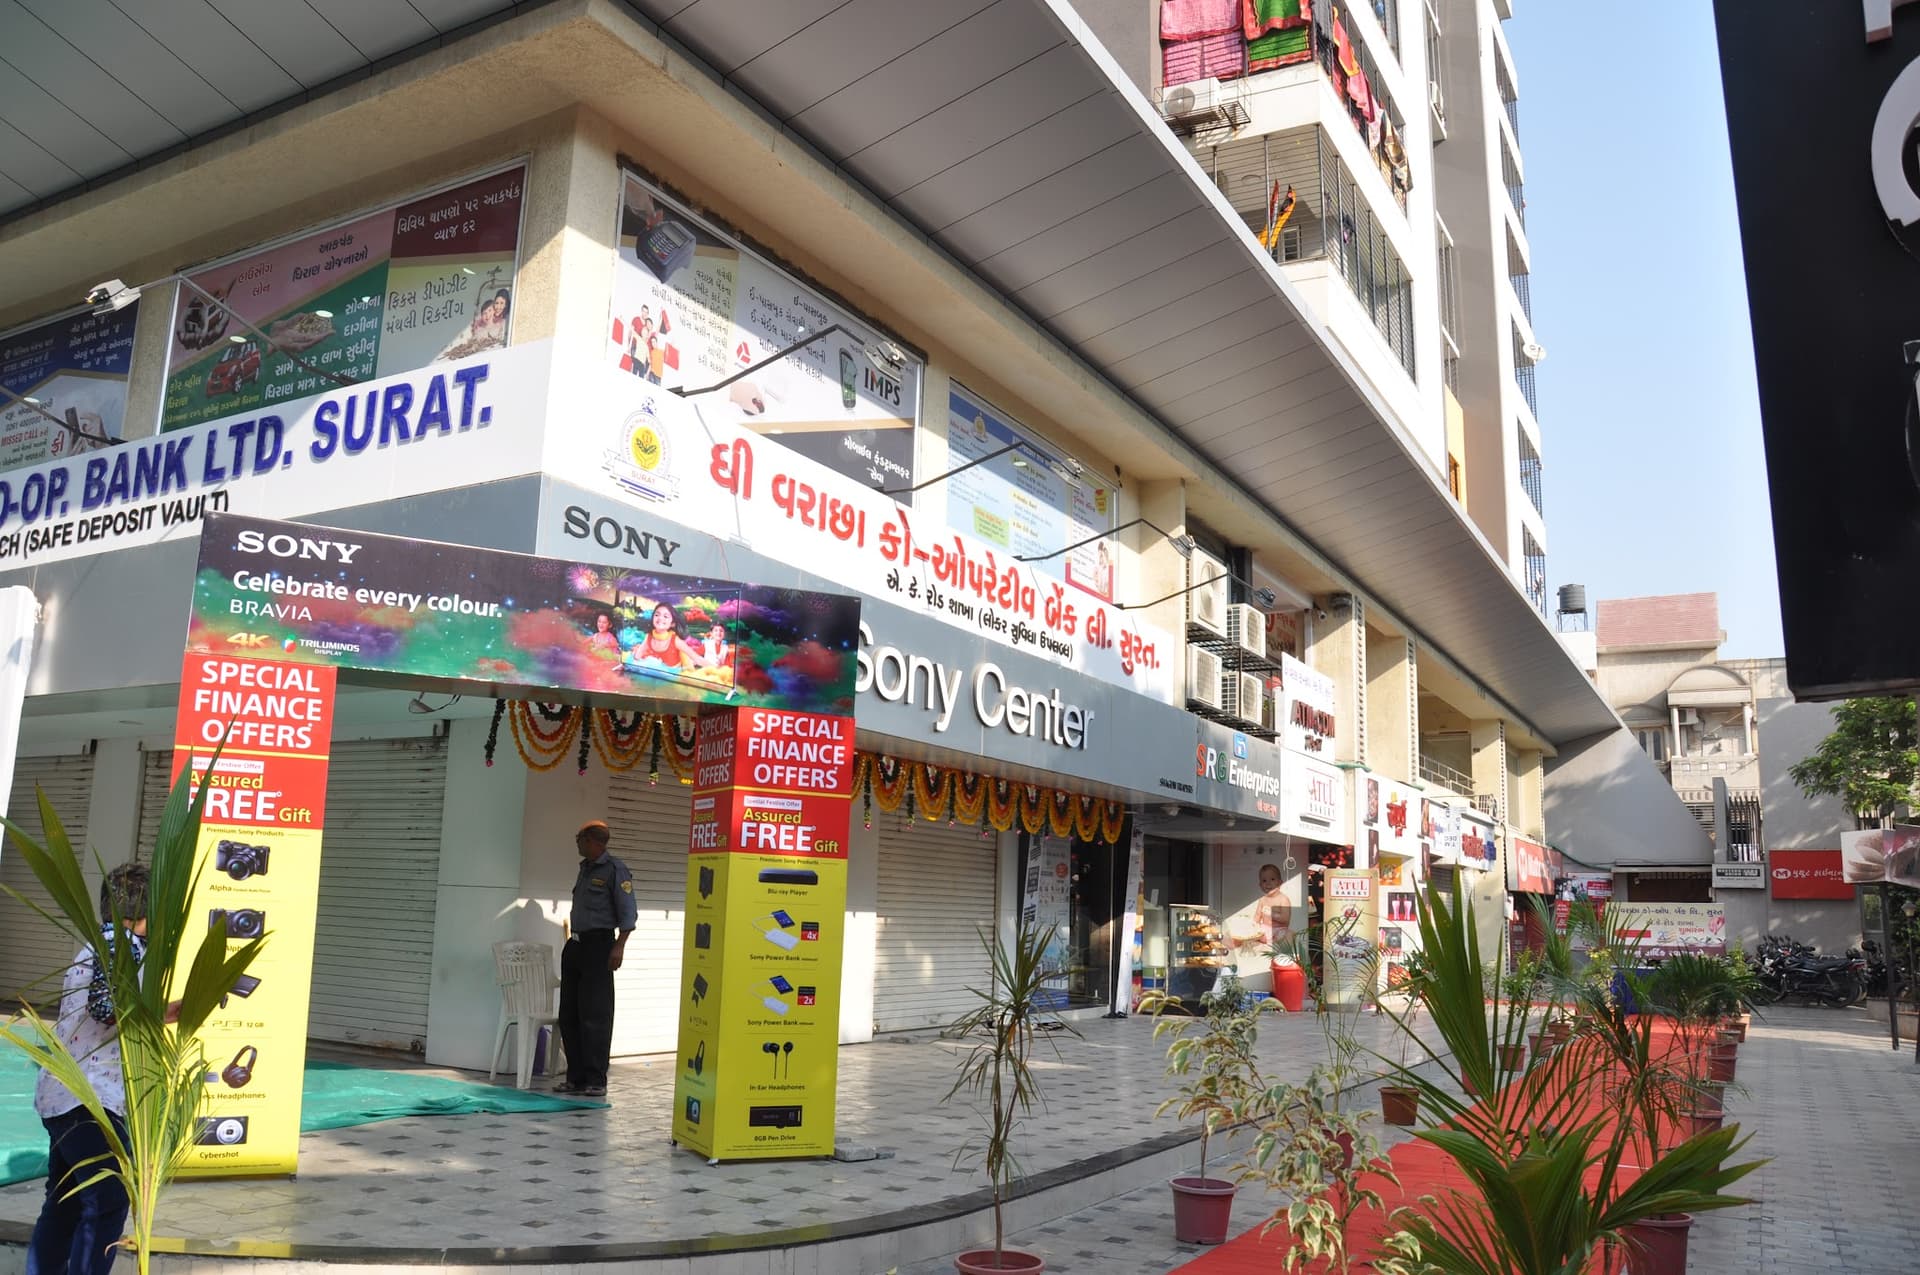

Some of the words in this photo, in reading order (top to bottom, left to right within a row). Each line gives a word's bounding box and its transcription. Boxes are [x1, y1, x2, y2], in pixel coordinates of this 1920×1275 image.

[465, 198, 479, 212] પર
[462, 220, 476, 234] દર
[864, 367, 900, 406] IMPS
[81, 435, 195, 513] BANK
[202, 414, 293, 487] LTD.
[309, 363, 493, 464] SURAT.
[24, 522, 73, 560] (SAFE
[77, 505, 157, 544] DEPOSIT
[564, 505, 681, 568] SONY
[236, 529, 363, 564] SONY
[772, 473, 866, 549] વરાછા
[879, 508, 1035, 620] કો-ઓપરેટીવ
[1086, 607, 1113, 650] લી.
[1120, 629, 1160, 676] સુરત.
[233, 570, 350, 602] Celebrate
[355, 586, 421, 614] every
[426, 592, 503, 618] colour.
[886, 568, 903, 593] એ.
[909, 576, 922, 600] કે.
[927, 584, 944, 609] રોડ
[948, 598, 974, 621] શાખા
[230, 599, 313, 622] BRAVIA
[226, 632, 270, 648] 4K
[299, 638, 361, 653] TRILUMINOS
[201, 661, 321, 693] SPECIAL
[855, 619, 963, 733] Sony
[973, 662, 1096, 750] Center
[194, 689, 323, 721] FINANCE
[700, 713, 734, 739] SPECIAL
[752, 712, 844, 740] SPECIAL
[697, 737, 734, 763] FINANCE
[748, 737, 845, 765] FINANCE
[1196, 743, 1228, 784] SRG
[1228, 759, 1280, 798] Enterprise
[1310, 776, 1336, 806] ATUL
[279, 807, 312, 823] Gift
[743, 808, 802, 823] Assured
[238, 828, 254, 837] Sony
[691, 822, 717, 849] FREE
[814, 840, 839, 853] Gift
[209, 884, 232, 892] Alpha
[790, 888, 808, 896] Player
[1337, 880, 1368, 891] ATUL
[807, 931, 817, 940] 4x
[804, 996, 813, 1005] 2x
[217, 1092, 266, 1100] Headphones
[769, 1084, 805, 1092] Headphones
[200, 1151, 239, 1160] Cybershot
